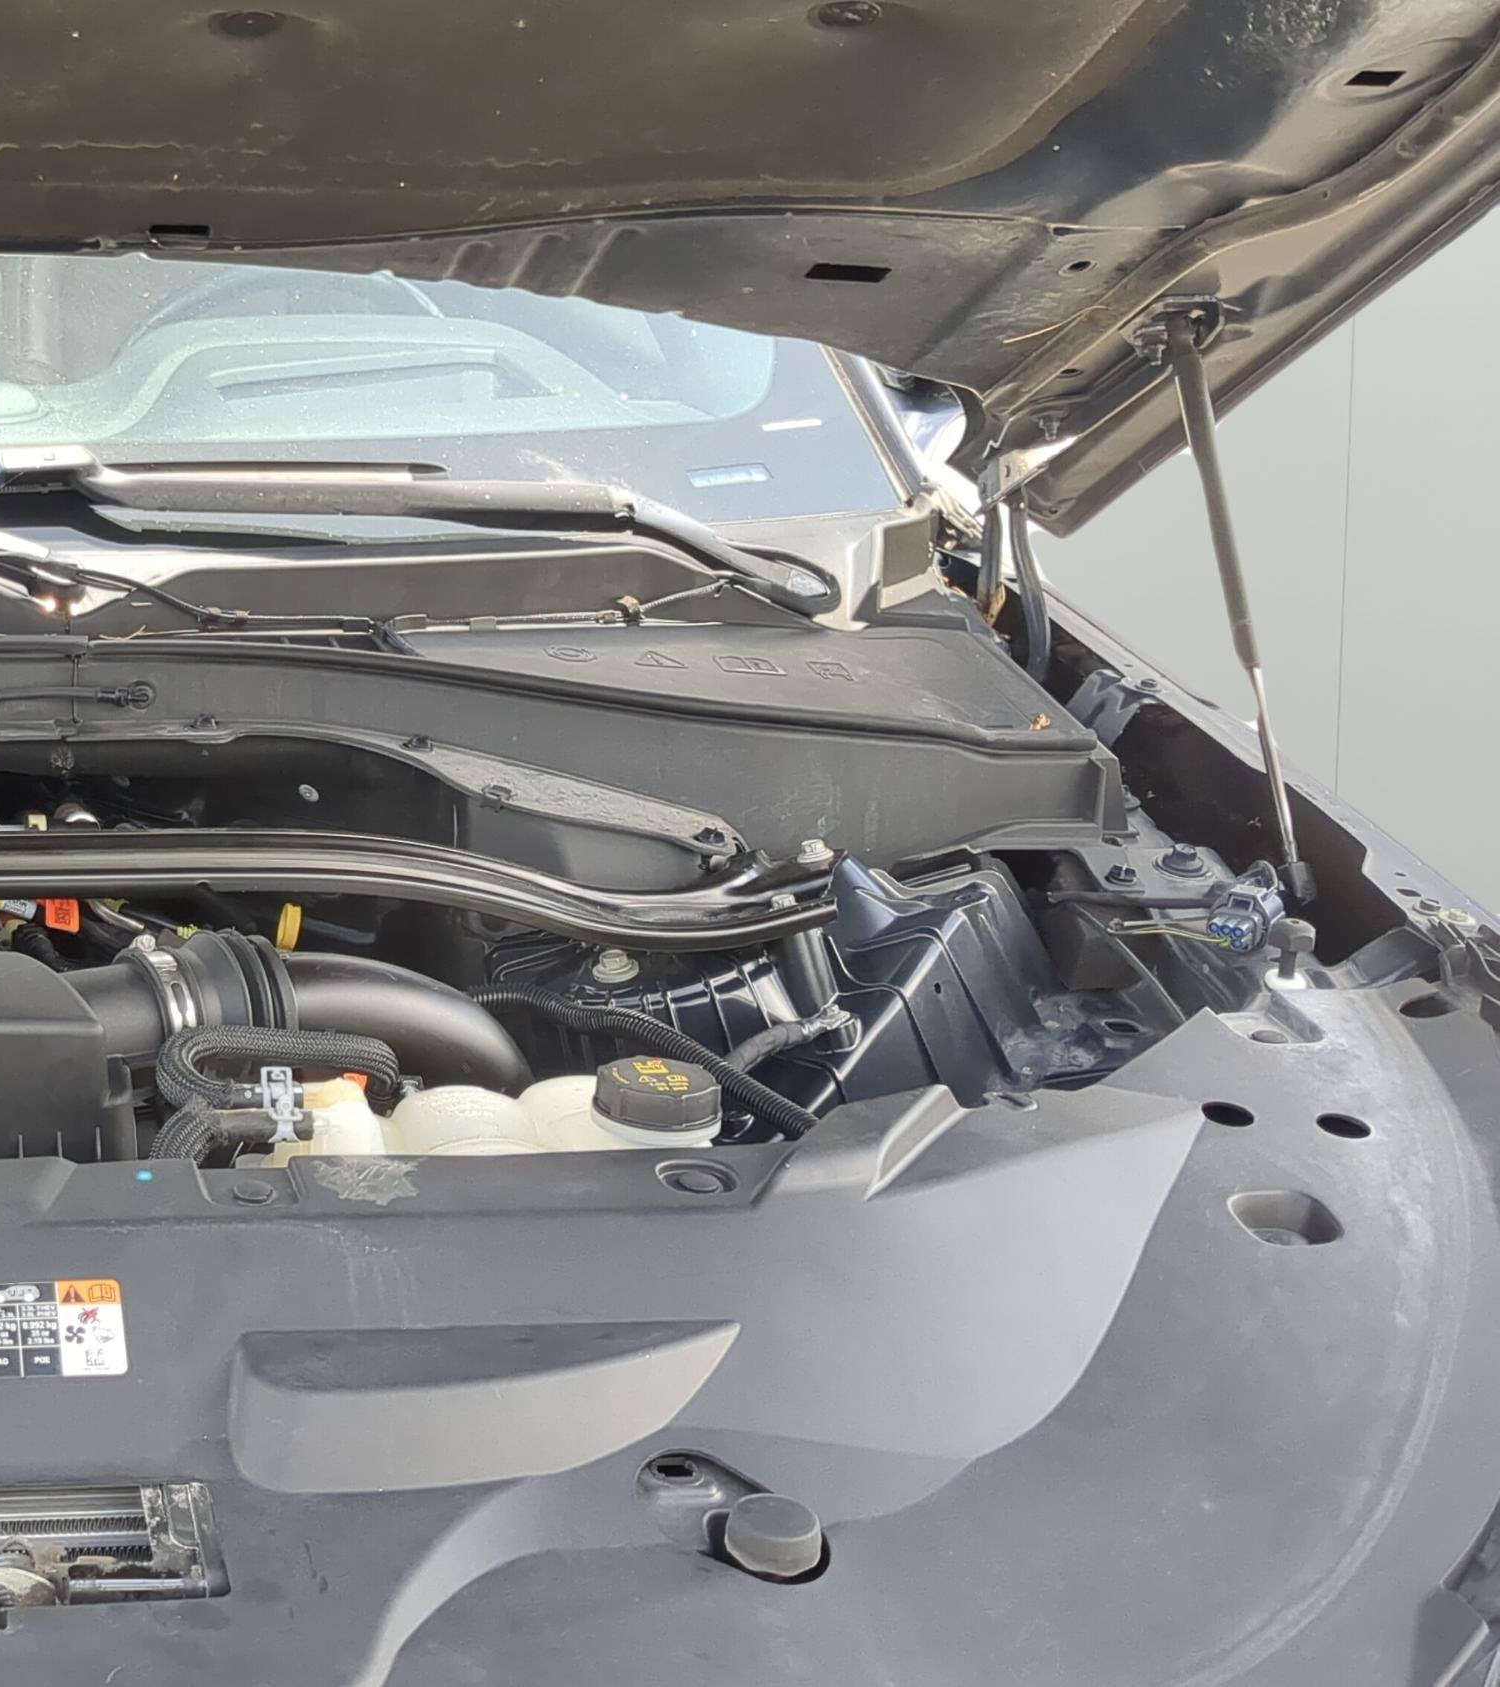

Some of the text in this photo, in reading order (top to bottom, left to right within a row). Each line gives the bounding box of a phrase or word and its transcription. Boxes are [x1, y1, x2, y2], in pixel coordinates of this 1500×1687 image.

[5, 1321, 16, 1332] kg
[46, 1320, 57, 1330] kg
[33, 1355, 51, 1364] POE
